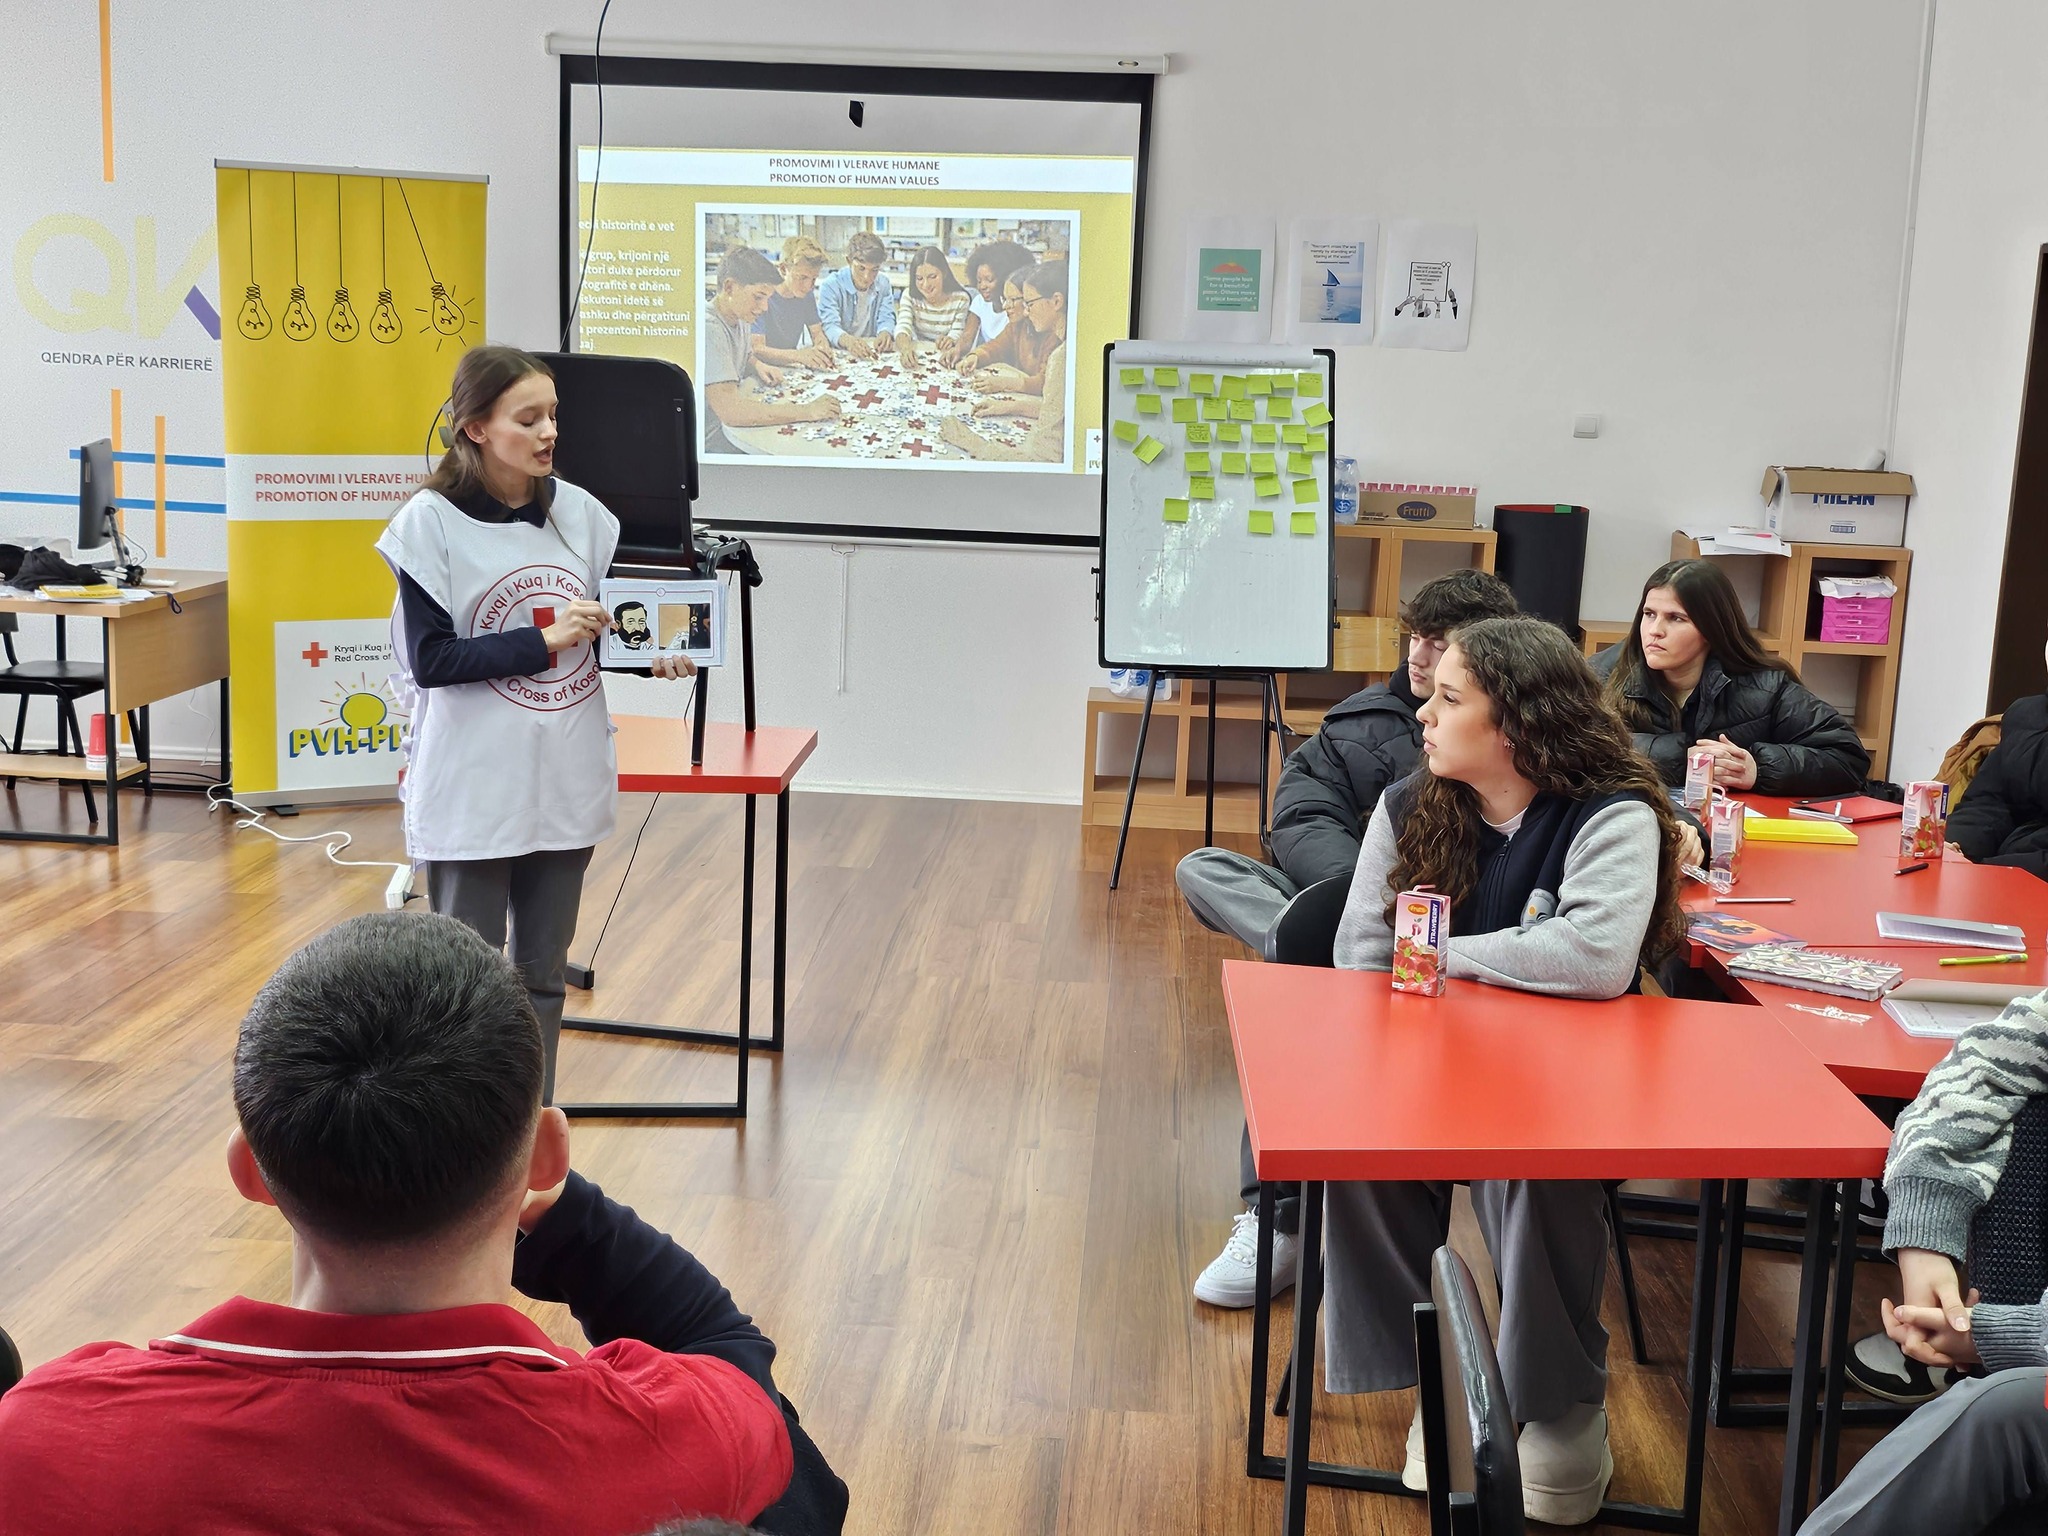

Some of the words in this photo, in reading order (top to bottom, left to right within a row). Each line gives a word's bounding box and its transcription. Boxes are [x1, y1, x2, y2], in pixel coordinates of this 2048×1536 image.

[770, 158, 834, 169] PROMOVIMI
[837, 159, 841, 169] I
[843, 159, 889, 170] VLERAVE
[892, 160, 941, 171] HUMANE
[769, 173, 836, 184] PROMOTION
[838, 175, 853, 184] OF
[855, 175, 897, 185] HUMAN
[899, 176, 940, 186] VALUES
[602, 219, 647, 231] historinë
[649, 223, 656, 231] e
[657, 222, 675, 232] vet
[619, 250, 652, 262] krijoni
[653, 251, 670, 263] një
[608, 265, 633, 276] duke
[635, 266, 682, 277] përdorur
[630, 283, 637, 291] e
[639, 280, 674, 292] dhëna.
[624, 295, 651, 306] idetë
[652, 296, 664, 306] së
[611, 310, 633, 320] dhe
[634, 310, 691, 323] përgatituni
[586, 325, 642, 336] prezentoni
[643, 325, 689, 337] historinë
[41, 352, 103, 366] QENDRA
[106, 352, 135, 368] PËR
[139, 355, 213, 372] KARRIERË
[255, 473, 335, 485] PROMOVIMI
[338, 473, 342, 485] I
[345, 473, 402, 485] VLERAVE
[255, 490, 338, 502] PROMOTION
[341, 490, 359, 502] OF
[1812, 493, 1876, 506] MILAN
[1402, 505, 1431, 518] Frutti
[480, 594, 508, 630] Kryqi
[513, 575, 544, 594] Kuq
[547, 573, 551, 586] i
[334, 644, 358, 653] Kryqi
[360, 643, 363, 651] i
[364, 643, 382, 652] Kuq
[384, 643, 387, 651] i
[334, 654, 352, 662] Red
[354, 654, 380, 662] Cross
[382, 653, 392, 661] of
[507, 678, 550, 703] Cross
[554, 687, 568, 702] of
